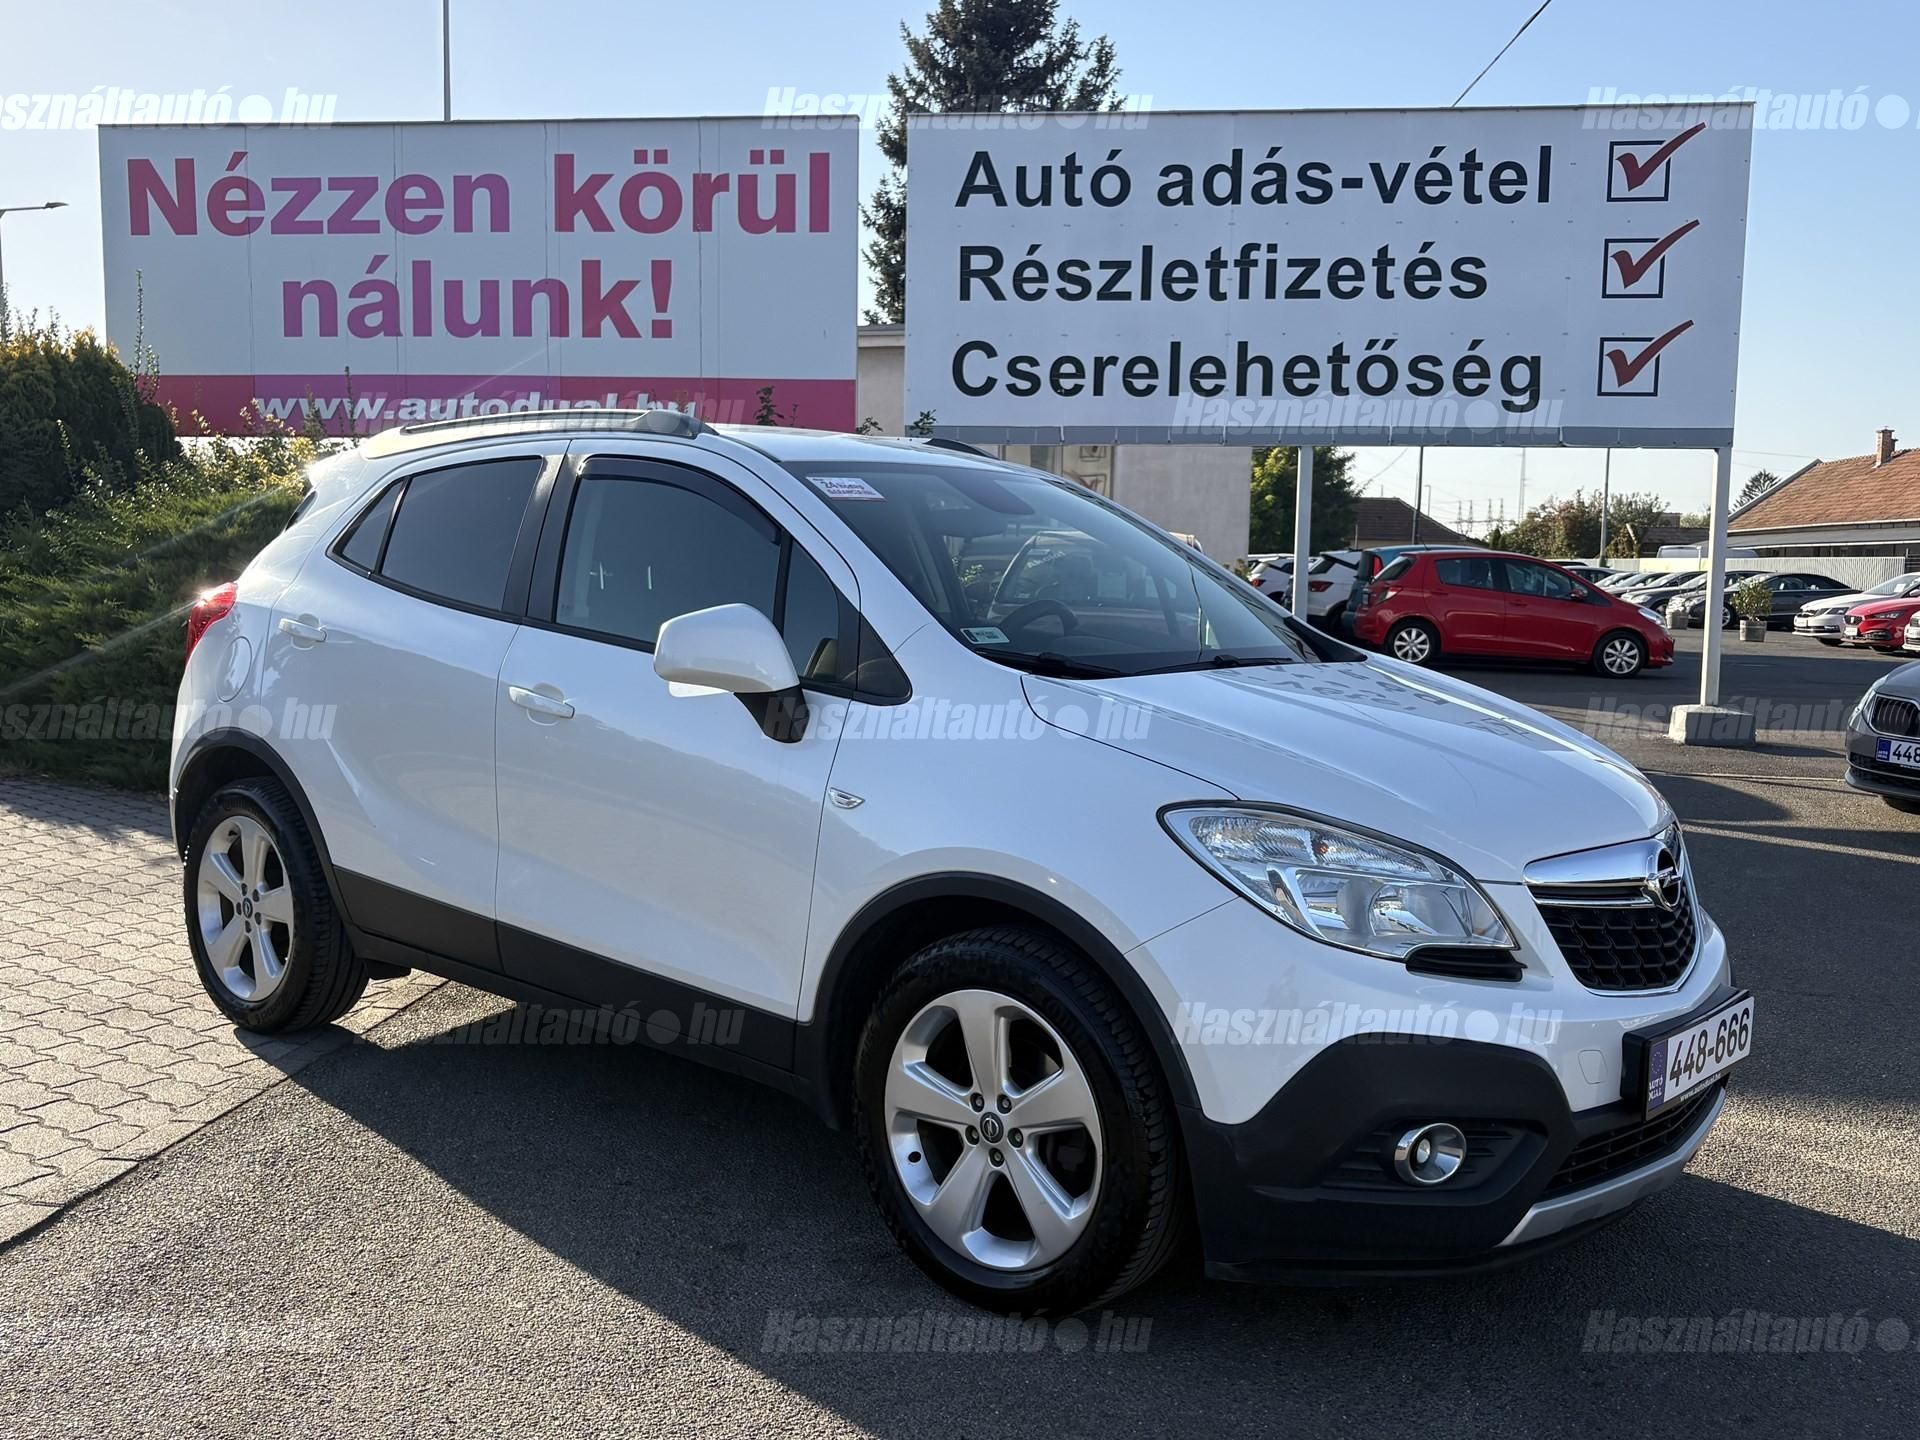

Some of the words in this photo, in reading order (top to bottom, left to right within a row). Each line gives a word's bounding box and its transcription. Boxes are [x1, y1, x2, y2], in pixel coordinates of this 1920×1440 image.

[127, 151, 511, 238] Nézzen
[554, 149, 831, 235] körül
[955, 148, 1133, 208] Autó
[1157, 145, 1552, 206] adás-vétel
[282, 255, 673, 339] nálunk!
[959, 240, 1489, 303] Részletfizetés
[952, 338, 1542, 412] Cserelehetőség
[1669, 1007, 1750, 1088] 448-666
